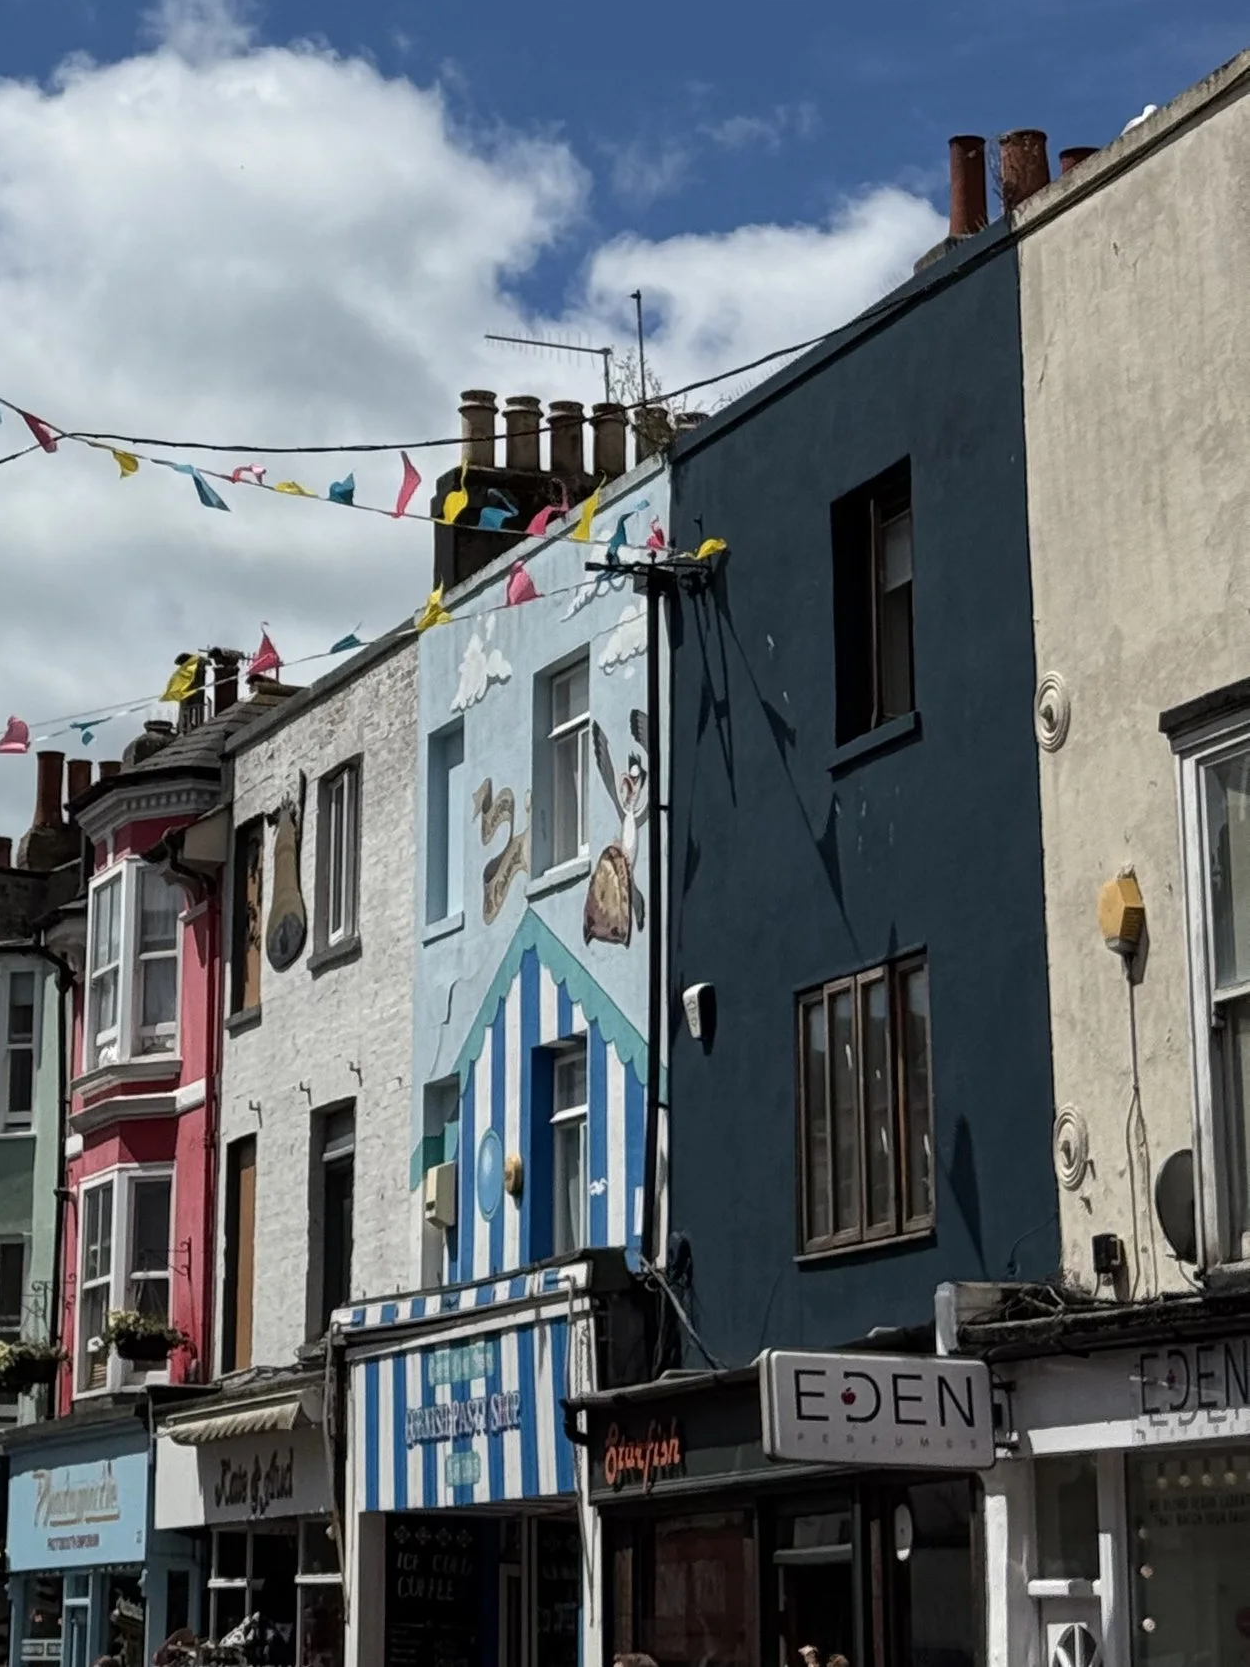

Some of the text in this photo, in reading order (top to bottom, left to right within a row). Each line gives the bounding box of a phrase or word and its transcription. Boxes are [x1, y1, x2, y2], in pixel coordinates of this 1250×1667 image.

[794, 1369, 976, 1428] EDEN
[1140, 1339, 1249, 1414] EDEN
[489, 1390, 522, 1434] SHOP
[796, 1431, 978, 1450] PERFUMES
